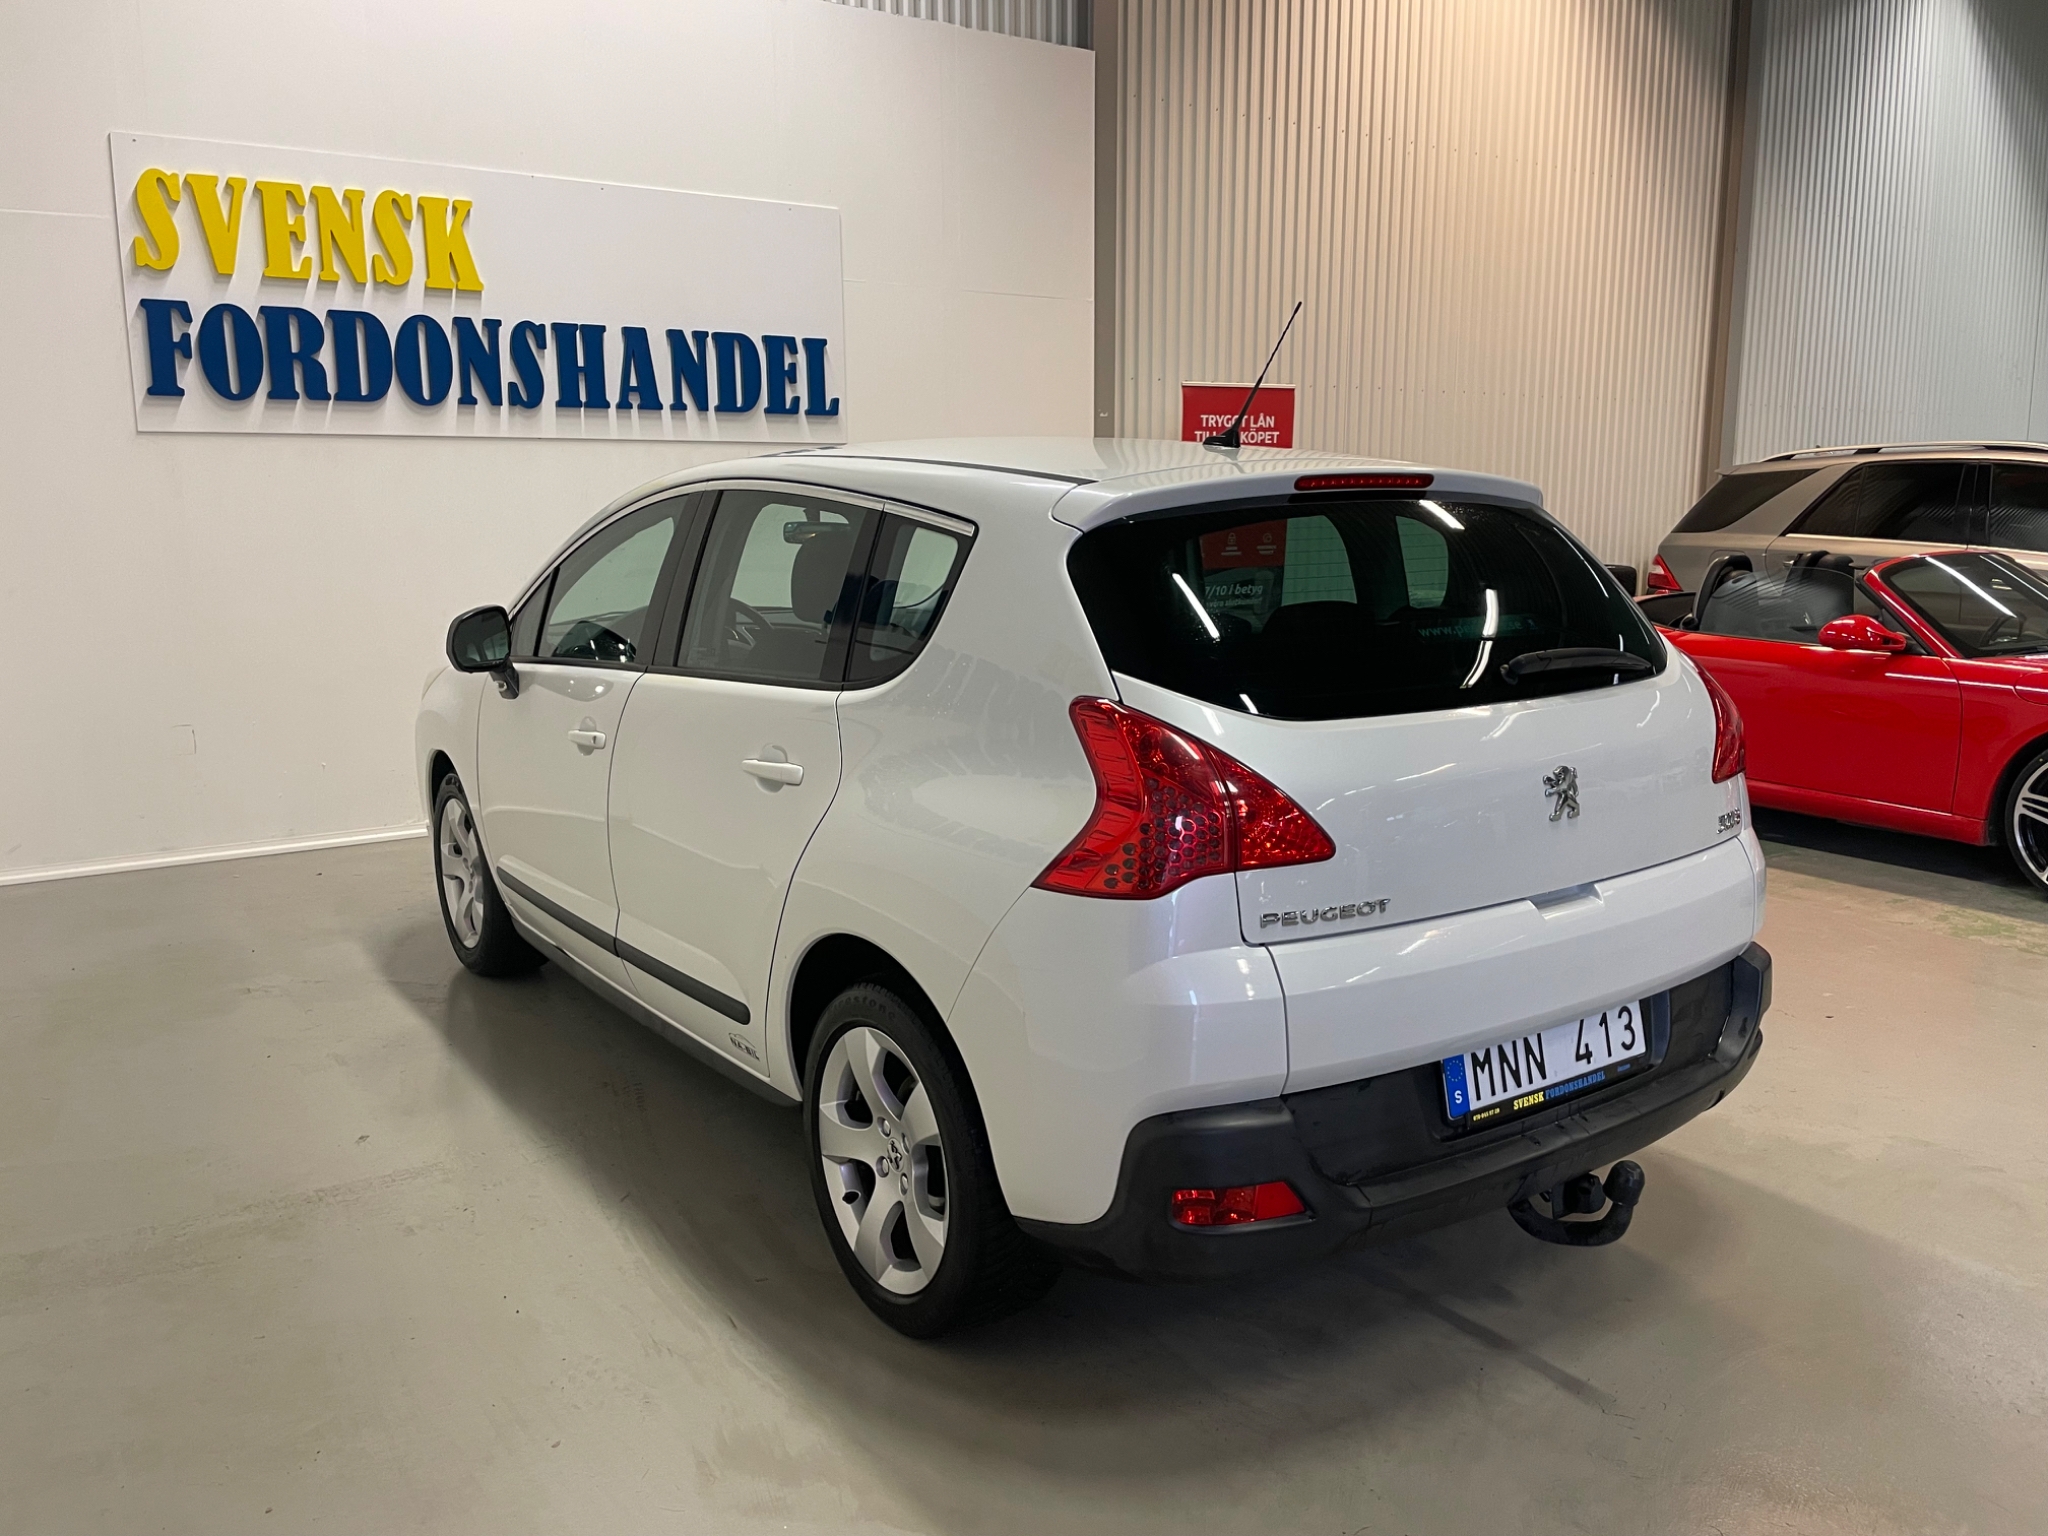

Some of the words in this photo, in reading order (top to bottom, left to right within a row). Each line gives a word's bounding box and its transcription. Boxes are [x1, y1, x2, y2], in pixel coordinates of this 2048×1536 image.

[134, 167, 485, 292] SVENSK
[138, 297, 841, 417] FORDONSHANDEL
[1250, 412, 1275, 428] LÅN
[1260, 898, 1391, 929] PEUGEOT
[1470, 1032, 1547, 1101] MNN
[1575, 1005, 1636, 1065] 413
[1454, 1089, 1463, 1104] S
[1513, 1091, 1545, 1110] SVENSK
[1545, 1070, 1606, 1100] FORDONSHANDEL
